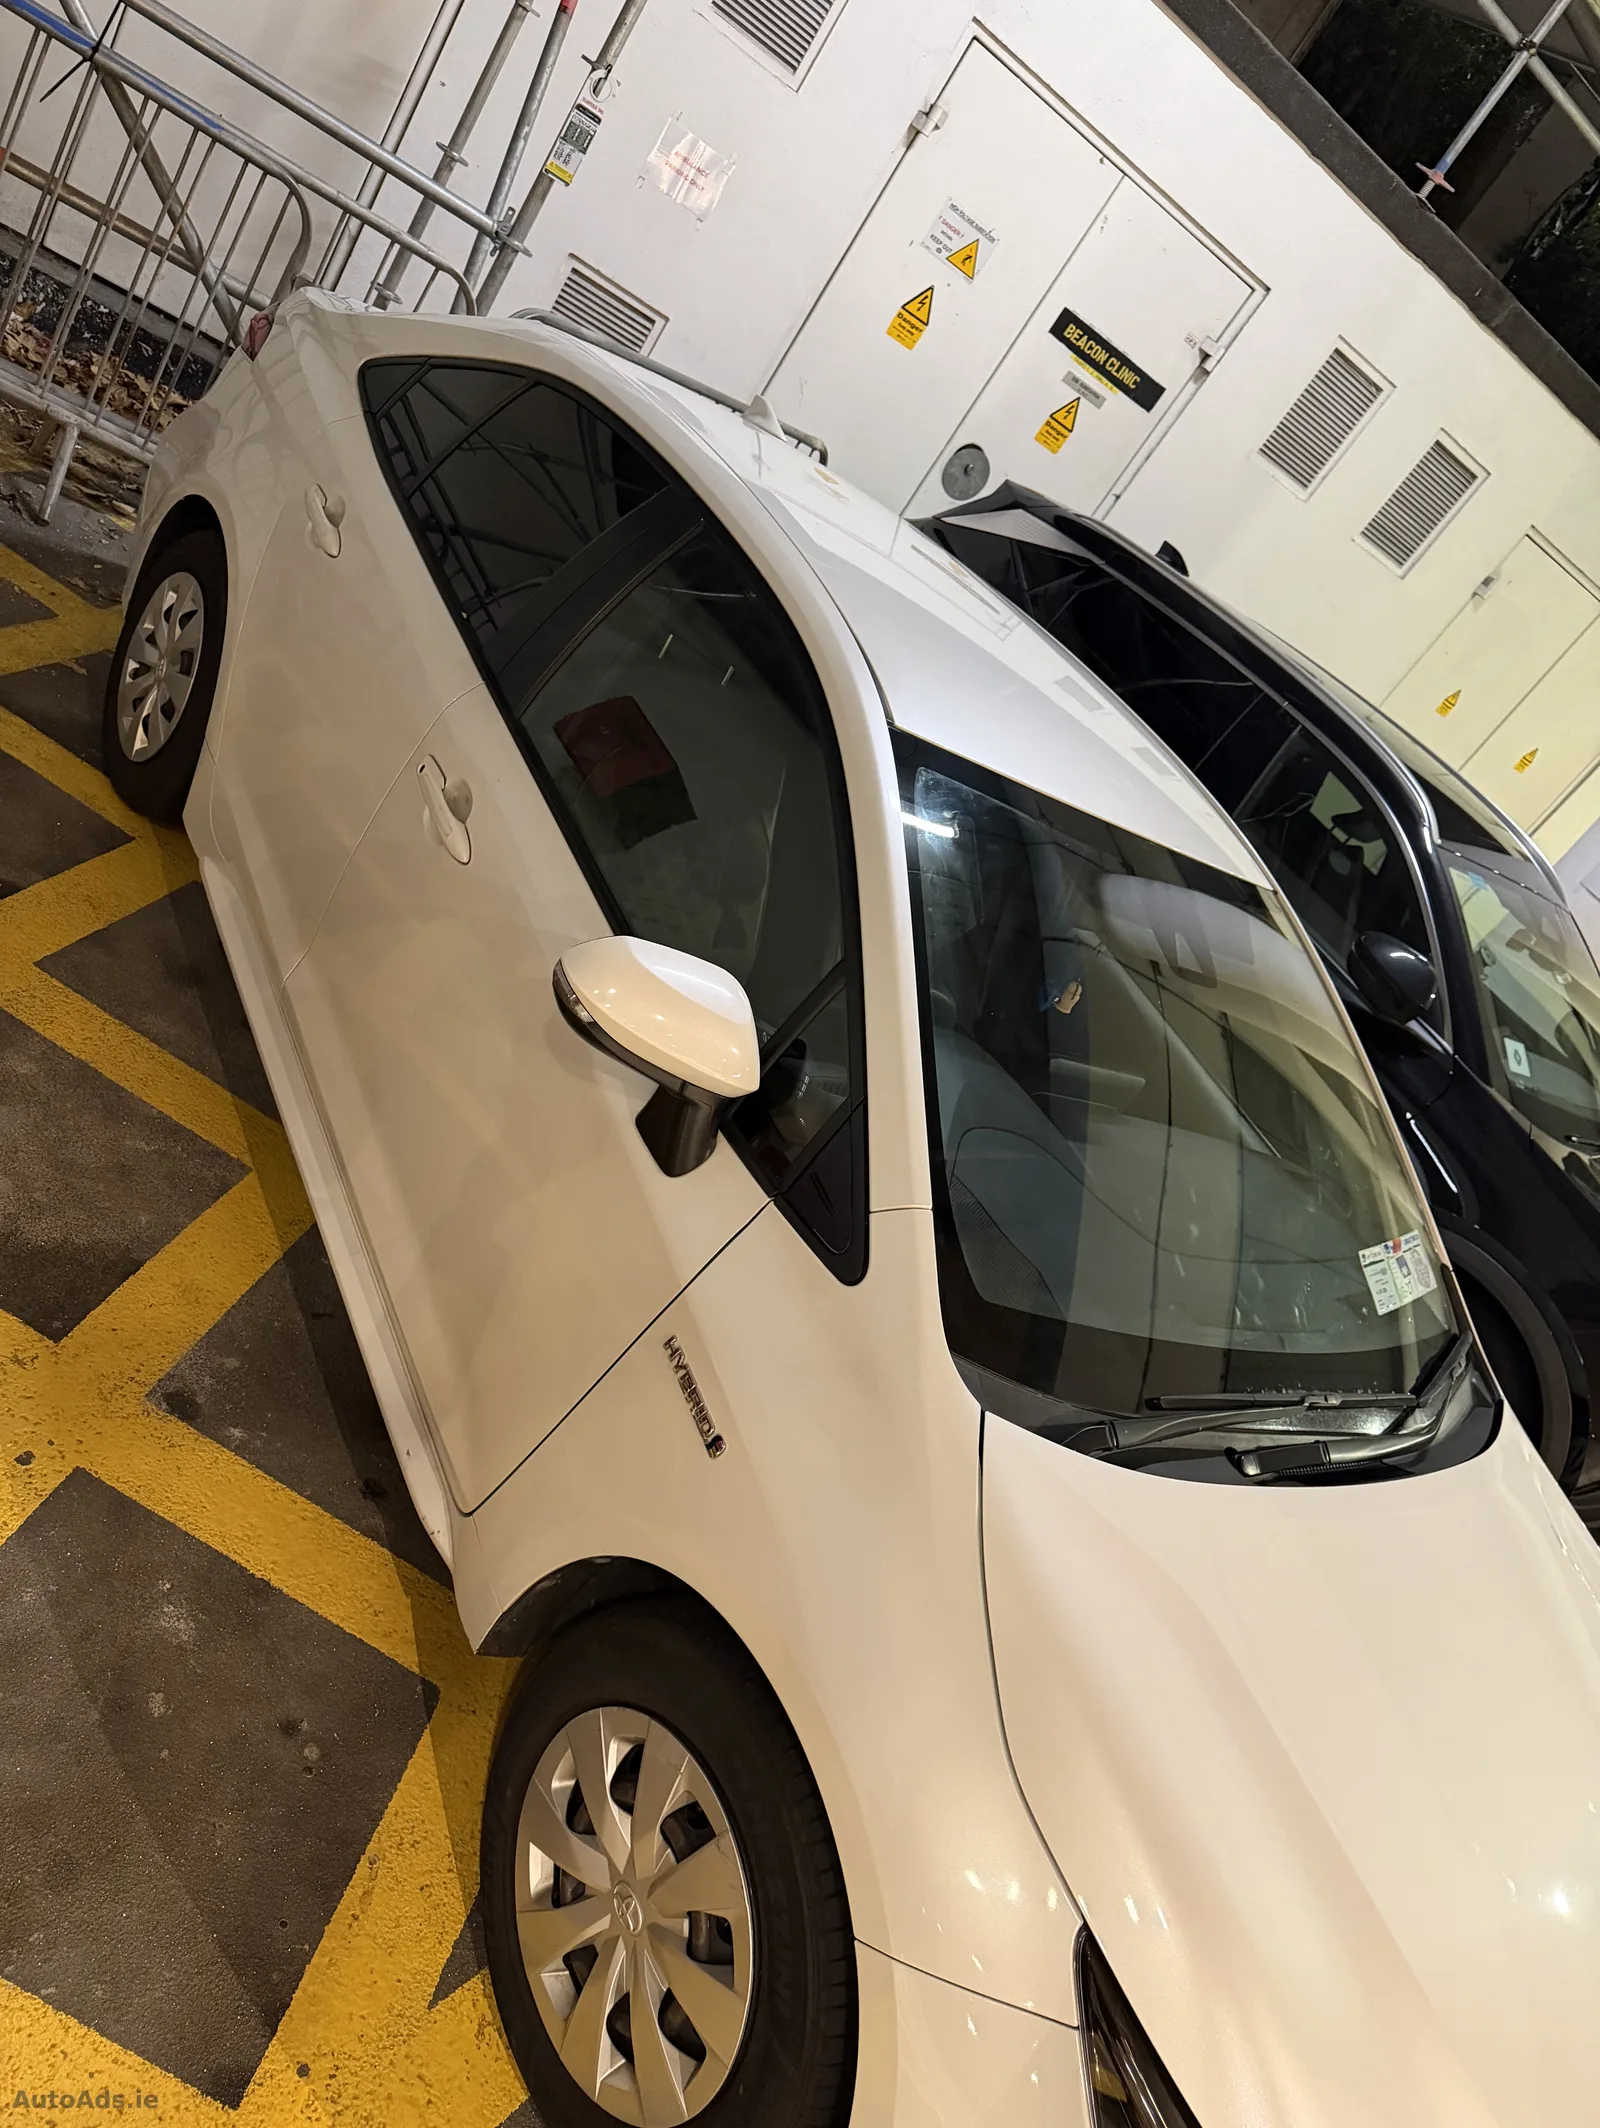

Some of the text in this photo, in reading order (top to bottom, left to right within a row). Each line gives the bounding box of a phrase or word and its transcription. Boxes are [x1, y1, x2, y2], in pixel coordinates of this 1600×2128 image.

[665, 160, 705, 192] PARKING ONLY
[674, 151, 710, 179] AMBULANCE
[930, 234, 943, 245] KEEP
[897, 312, 923, 333] Danger
[1063, 323, 1110, 365] BEACON
[1105, 357, 1141, 390] CLINIC
[1045, 420, 1069, 440] Danger
[662, 1334, 716, 1443] HYBRID
